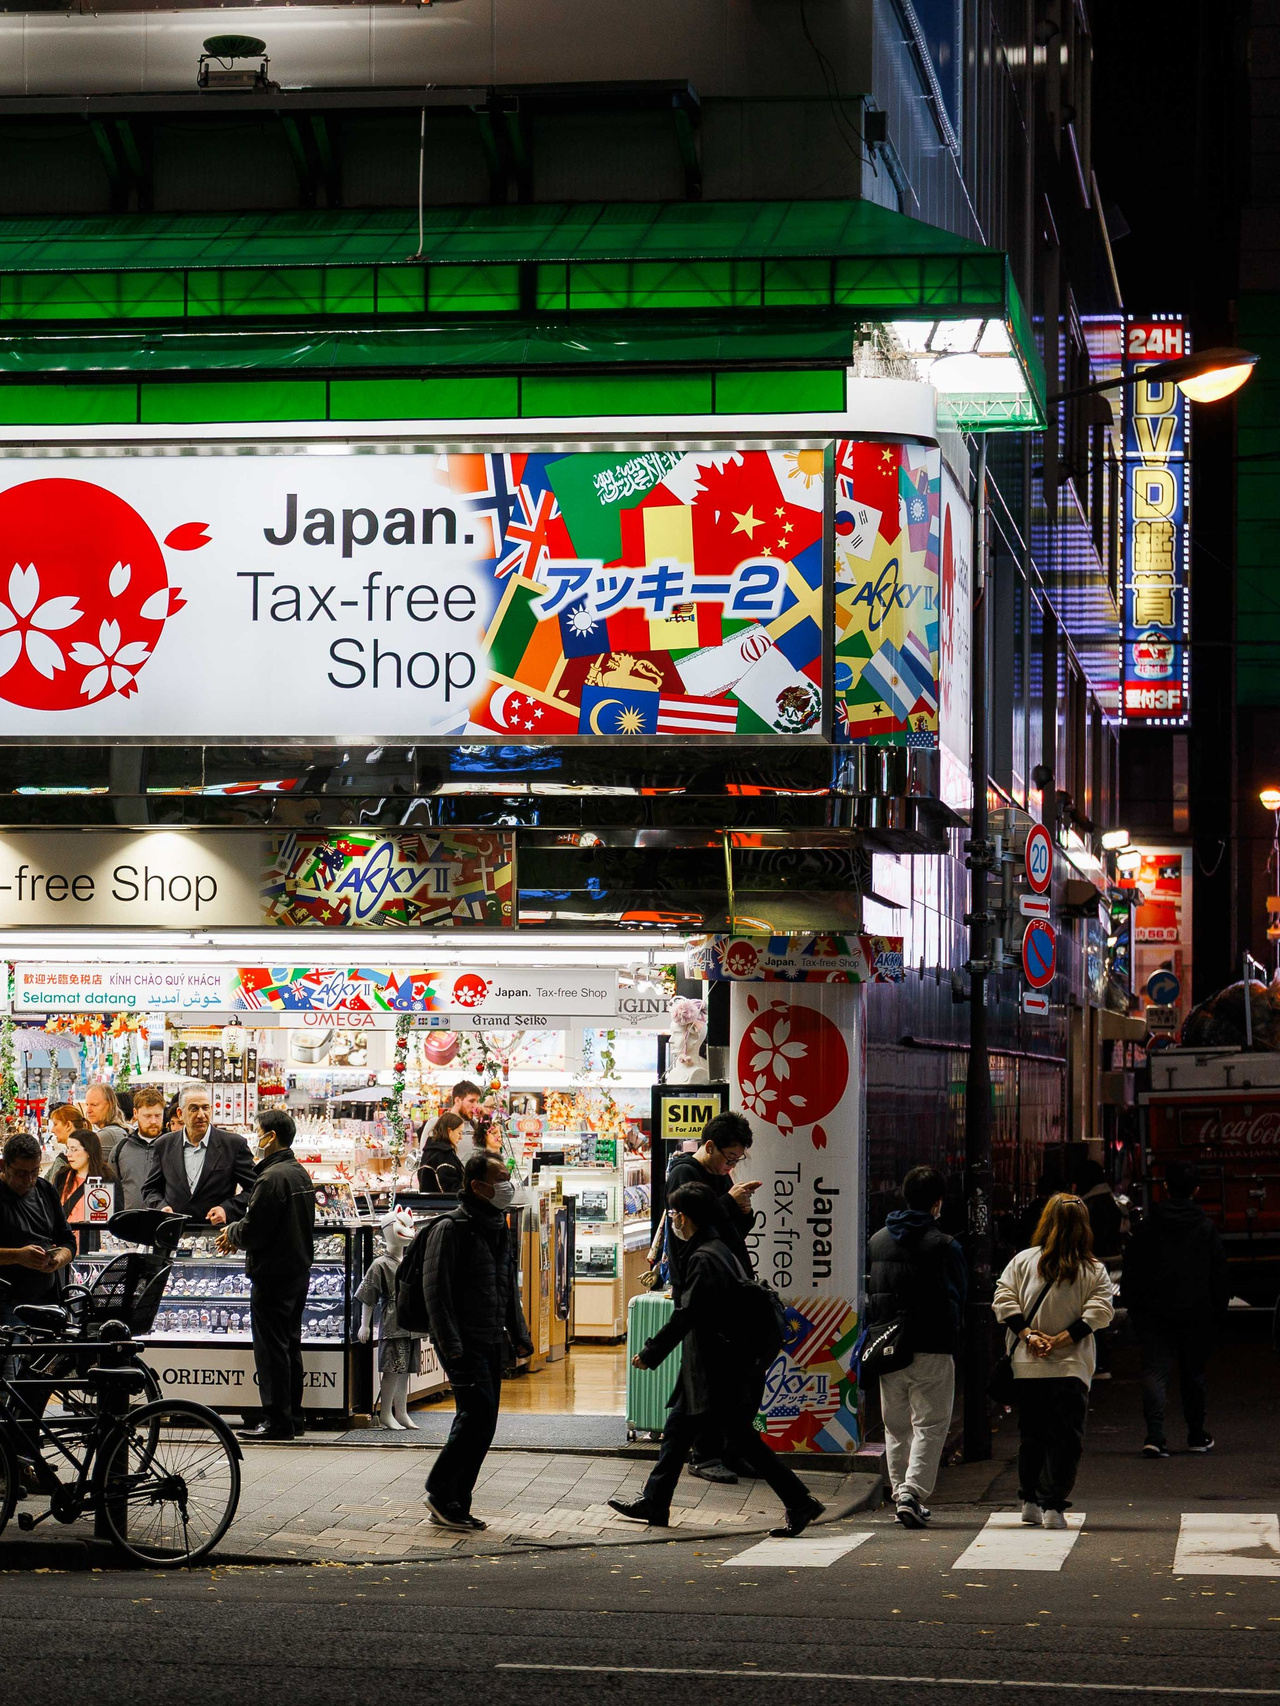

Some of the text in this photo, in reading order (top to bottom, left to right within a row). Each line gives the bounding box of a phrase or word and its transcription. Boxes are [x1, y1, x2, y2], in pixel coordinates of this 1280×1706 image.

[1128, 328, 1182, 355] 24H
[1132, 362, 1177, 628] DVD鑑賞
[263, 493, 475, 558] Japan.
[237, 571, 477, 622] Tax-free
[540, 564, 780, 612] アッキー2
[327, 638, 477, 702] Shop
[1032, 847, 1047, 874] 20
[112, 865, 218, 911] Shop
[765, 956, 859, 970] Japan. Tax-free Shop
[109, 972, 221, 986] KÍNH CHÀO QUÝ KHÁCH
[23, 991, 137, 1008] Selamat datang
[495, 987, 607, 1000] Japan. Tax-free Shop
[303, 1013, 376, 1027] OMEGA
[472, 1014, 548, 1026] Grand Seiko
[668, 1104, 713, 1123] SIM
[773, 1162, 801, 1289] Tax-free
[806, 1176, 840, 1289] Japan.
[162, 1368, 245, 1386] ORIENT
[776, 1394, 828, 1405] アッキー2
